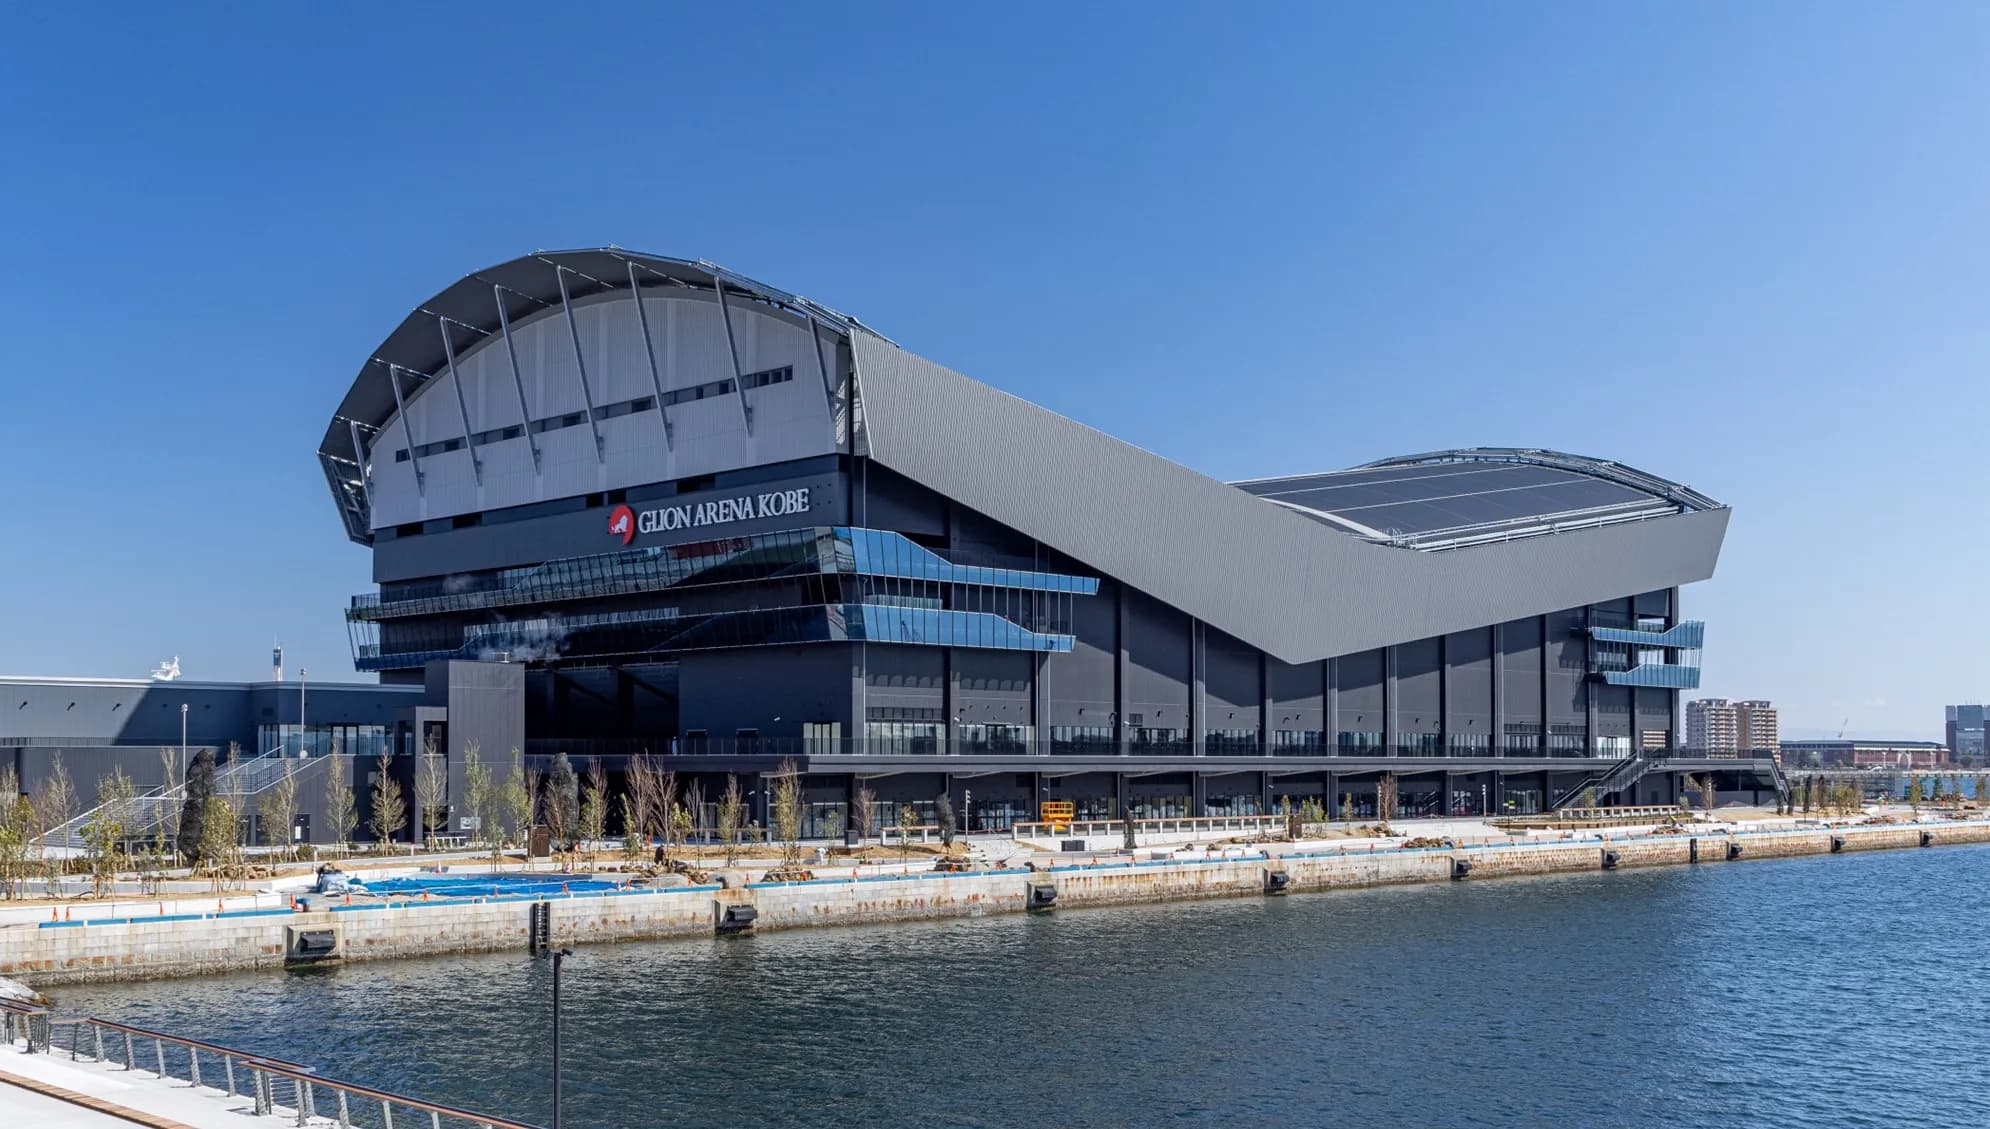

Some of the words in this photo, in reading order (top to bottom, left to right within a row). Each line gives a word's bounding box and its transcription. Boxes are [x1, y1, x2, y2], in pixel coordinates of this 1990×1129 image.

[638, 505, 692, 533] GLION
[693, 496, 755, 525] ARENA
[758, 488, 809, 518] KOBE
